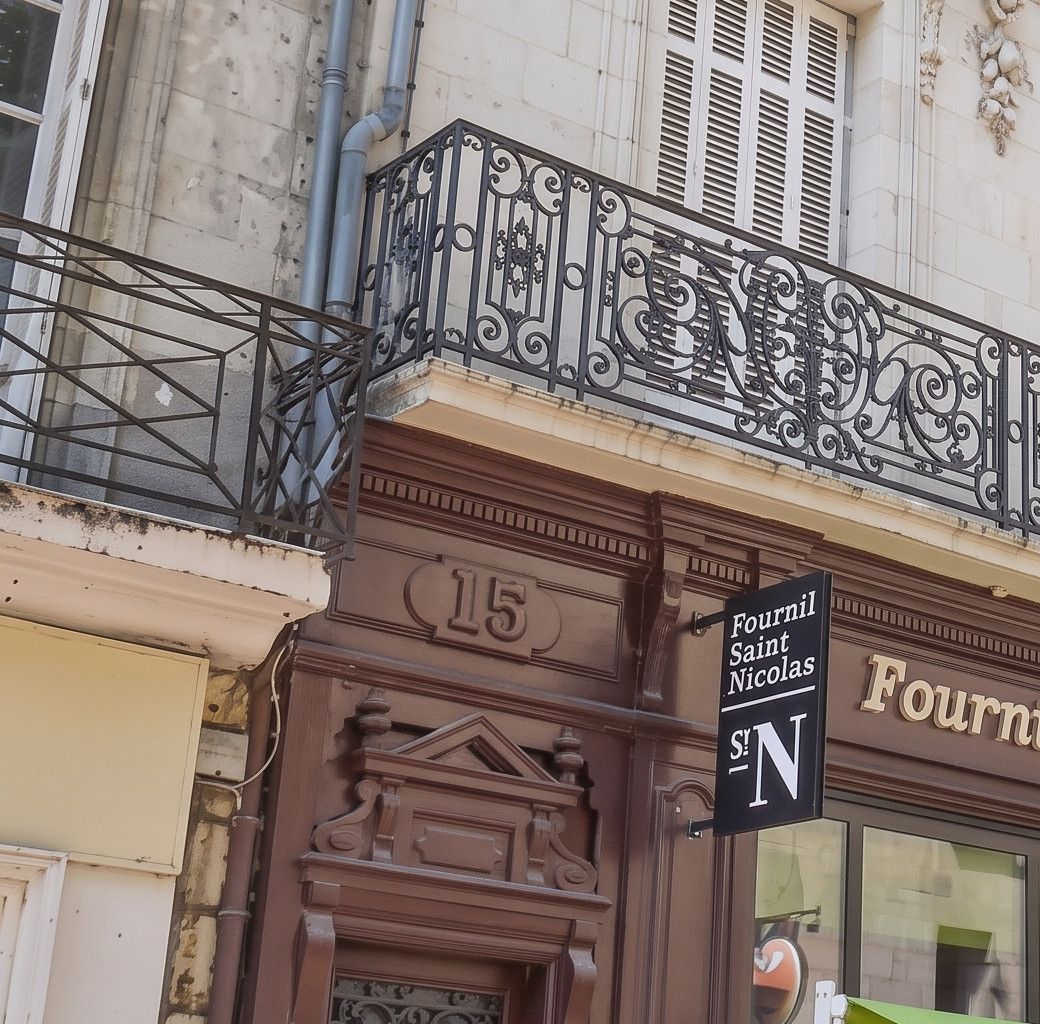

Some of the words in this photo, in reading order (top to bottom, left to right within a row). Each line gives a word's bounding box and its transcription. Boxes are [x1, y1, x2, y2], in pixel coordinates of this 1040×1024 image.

[448, 568, 528, 643] 15
[730, 590, 817, 639] Fournil
[729, 630, 790, 667] Saint
[727, 655, 816, 696] Nicolas
